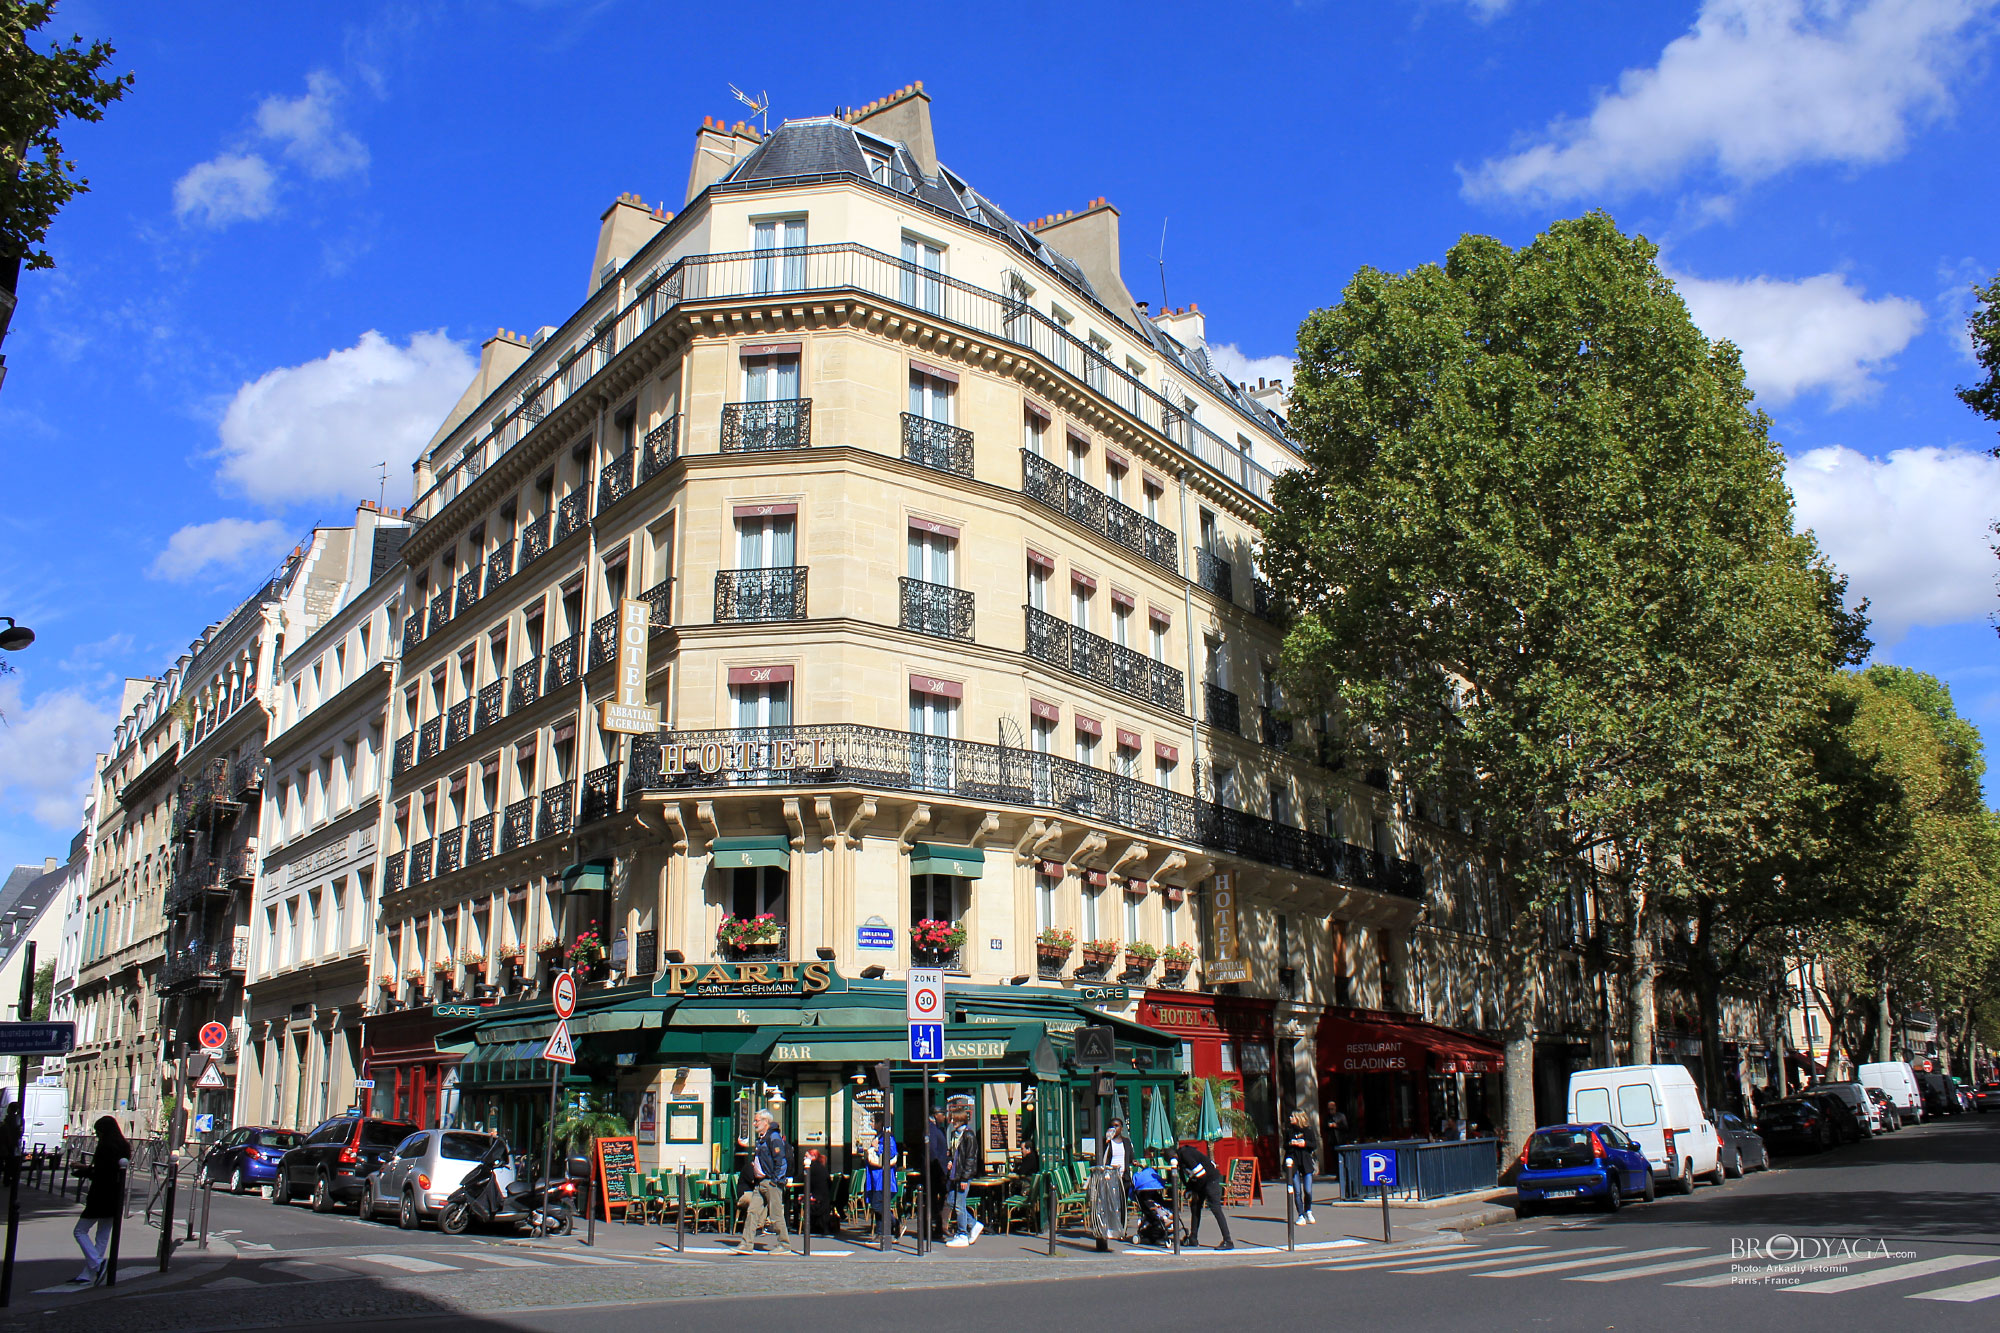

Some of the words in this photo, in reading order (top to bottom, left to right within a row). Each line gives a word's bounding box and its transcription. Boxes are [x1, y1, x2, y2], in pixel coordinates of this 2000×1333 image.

[625, 605, 646, 707] HOTEL
[610, 706, 652, 720] ABBATIAL
[606, 717, 614, 727] St
[616, 718, 654, 732] GERMAIN
[659, 738, 835, 775] HOTEL
[1215, 874, 1231, 961] HOTEL
[991, 940, 1002, 949] 46
[1209, 962, 1244, 972] ABBATIAL
[666, 962, 831, 994] PARIS
[1214, 970, 1246, 981] GERMAIN
[698, 985, 730, 994] SAINT
[742, 984, 794, 993] GERMAIN
[1085, 988, 1124, 999] CAFE
[920, 997, 932, 1005] 30
[436, 1006, 477, 1016] CAFE
[1160, 1009, 1200, 1025] HOTEL
[778, 1046, 812, 1059] BAR
[944, 1043, 1009, 1057] ASSERI
[1347, 1043, 1402, 1053] RESTAURANT
[1344, 1057, 1406, 1070] GLADINES
[1369, 1156, 1386, 1182] P
